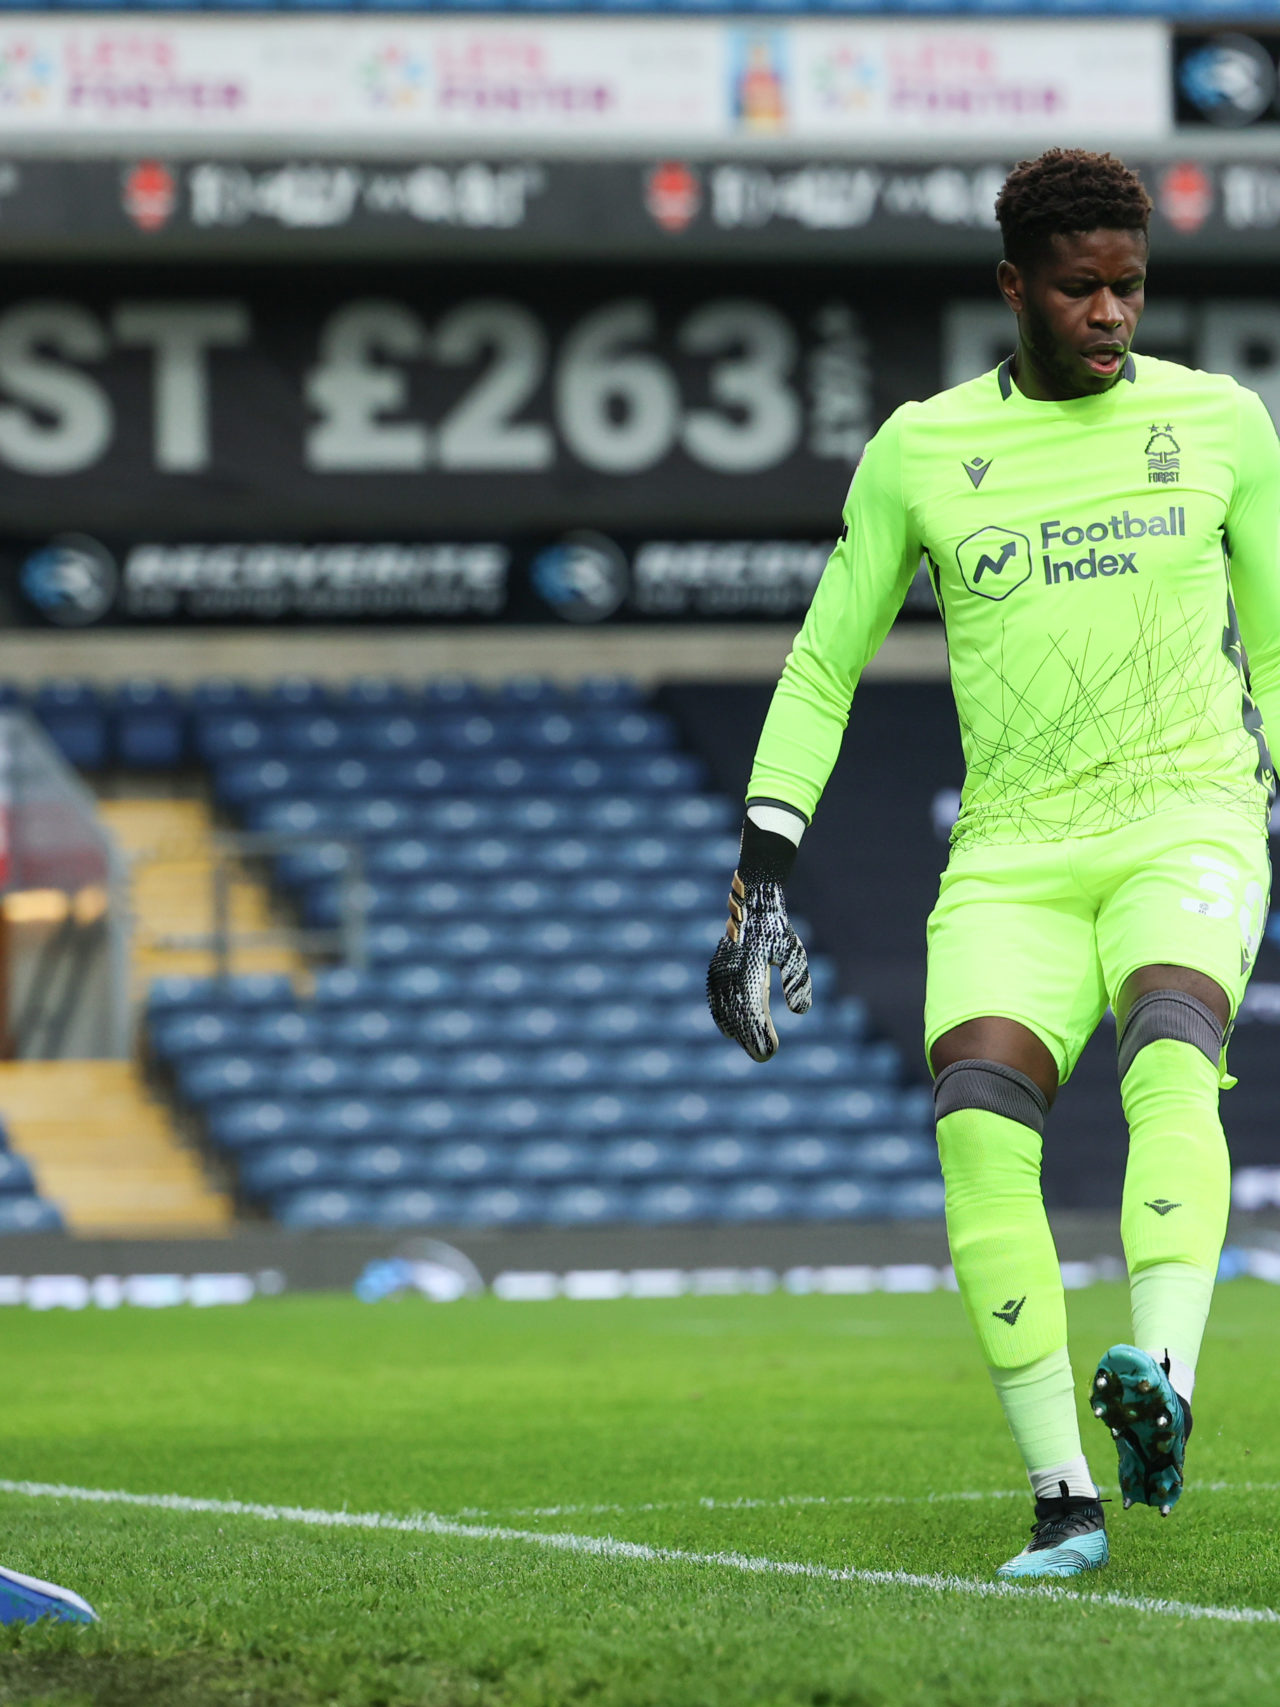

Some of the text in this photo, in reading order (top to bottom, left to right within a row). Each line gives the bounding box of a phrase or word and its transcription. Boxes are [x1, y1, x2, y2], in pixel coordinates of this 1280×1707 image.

[304, 302, 802, 474] £263
[1148, 470, 1180, 484] FOREST
[1040, 506, 1185, 549] Football
[1042, 549, 1139, 586] Index
